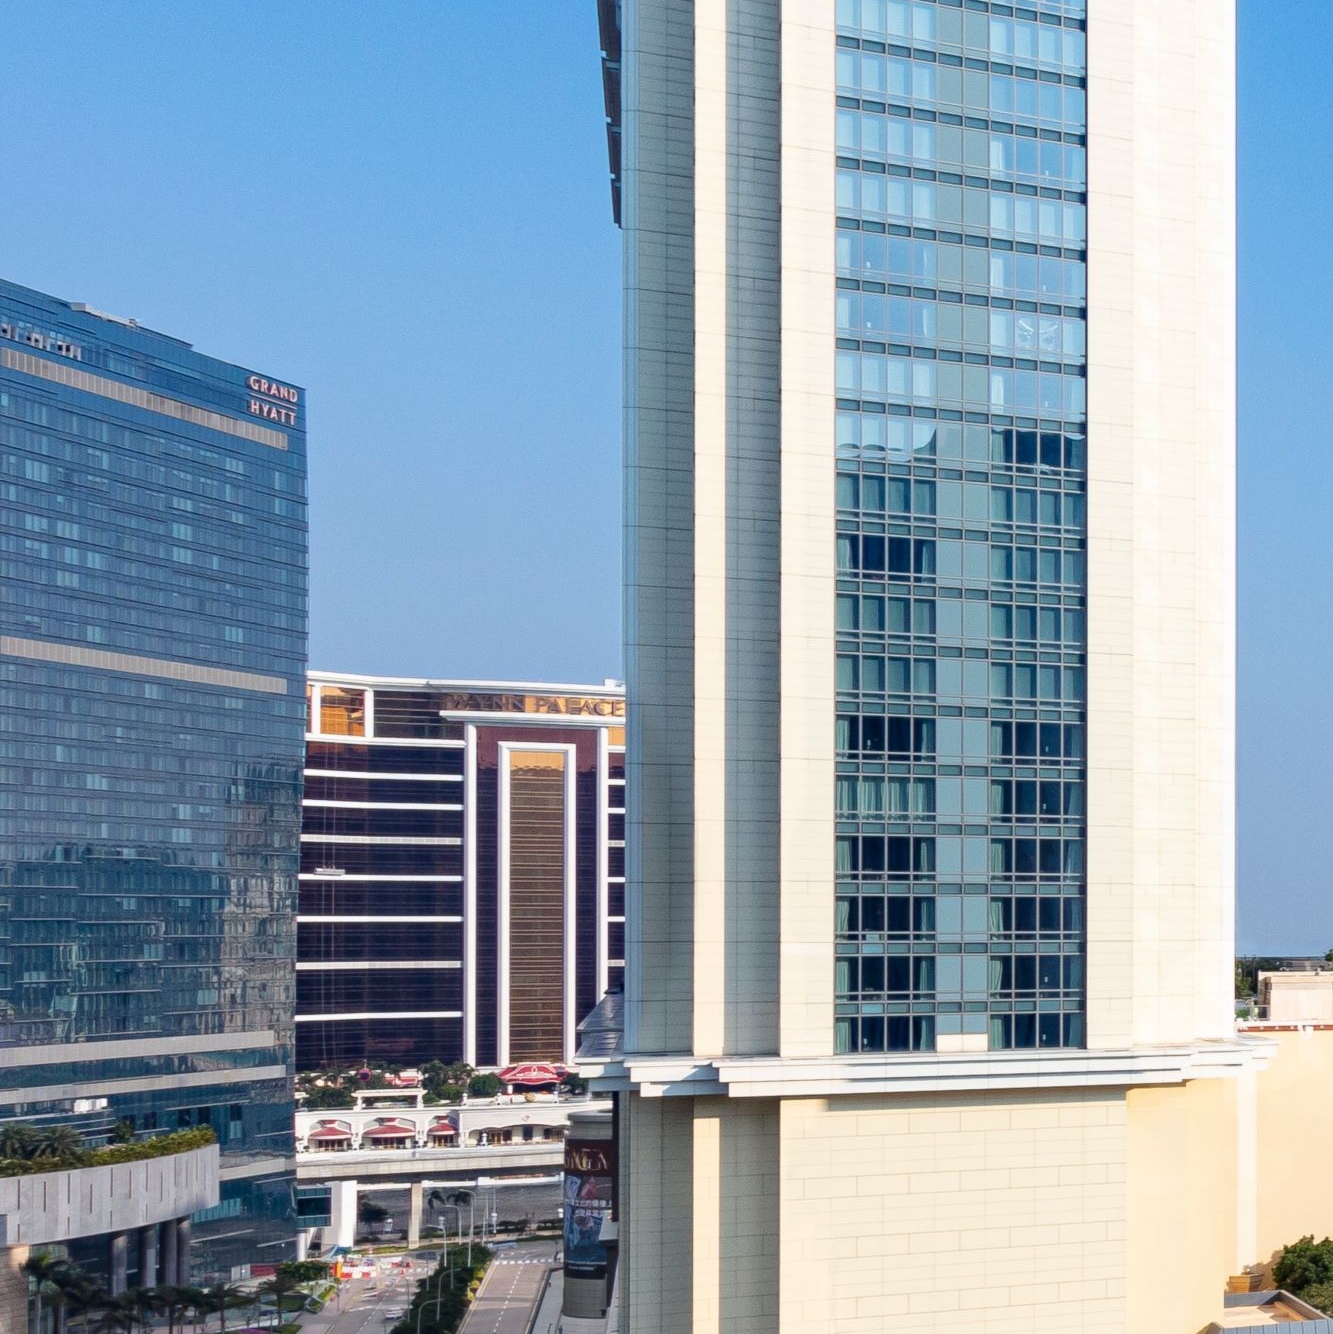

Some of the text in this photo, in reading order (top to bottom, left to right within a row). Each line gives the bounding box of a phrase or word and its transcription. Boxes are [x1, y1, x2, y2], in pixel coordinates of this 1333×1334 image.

[248, 375, 298, 403] GRAND
[249, 399, 298, 426] HYATT
[446, 693, 625, 717] WYNN PALACE
